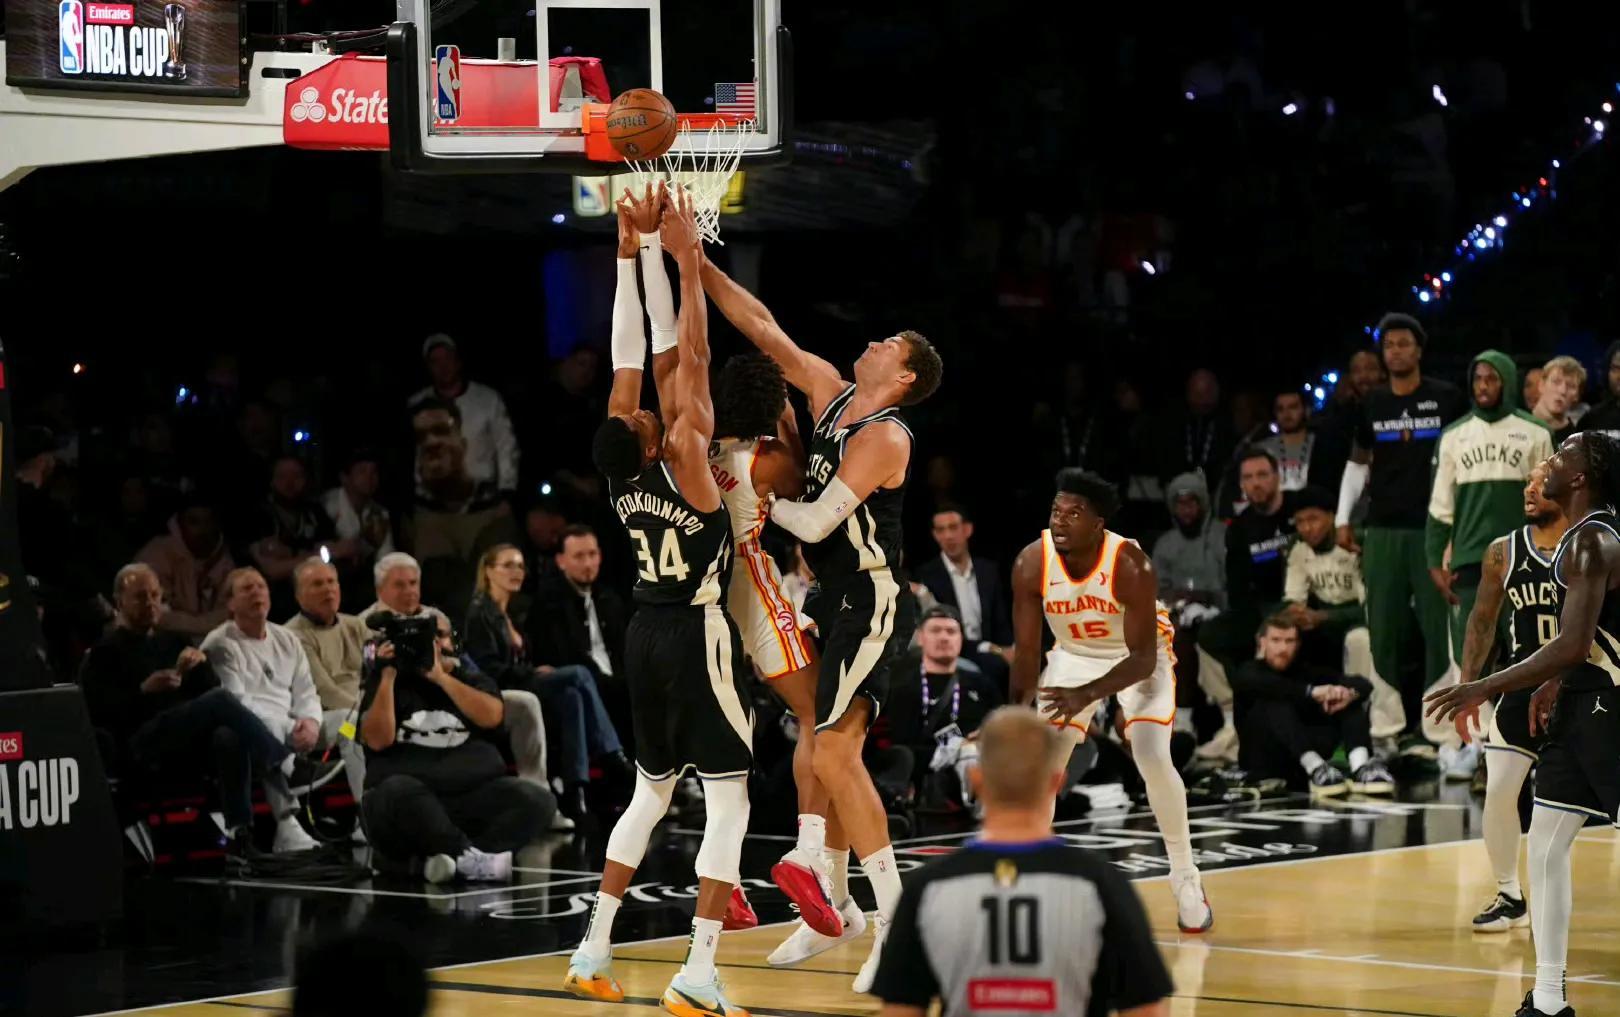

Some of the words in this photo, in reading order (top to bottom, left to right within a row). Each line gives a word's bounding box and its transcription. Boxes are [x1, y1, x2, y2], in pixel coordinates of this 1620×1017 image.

[89, 5, 131, 20] Emirates
[86, 25, 127, 75] NBA
[129, 26, 169, 77] CUP
[328, 88, 388, 124] State
[1461, 442, 1522, 470] BUCKS
[629, 527, 690, 583] 34
[1045, 595, 1121, 615] ATLANTA
[1068, 620, 1110, 640] 15
[18, 757, 80, 829] CUP
[981, 896, 1041, 965] 10
